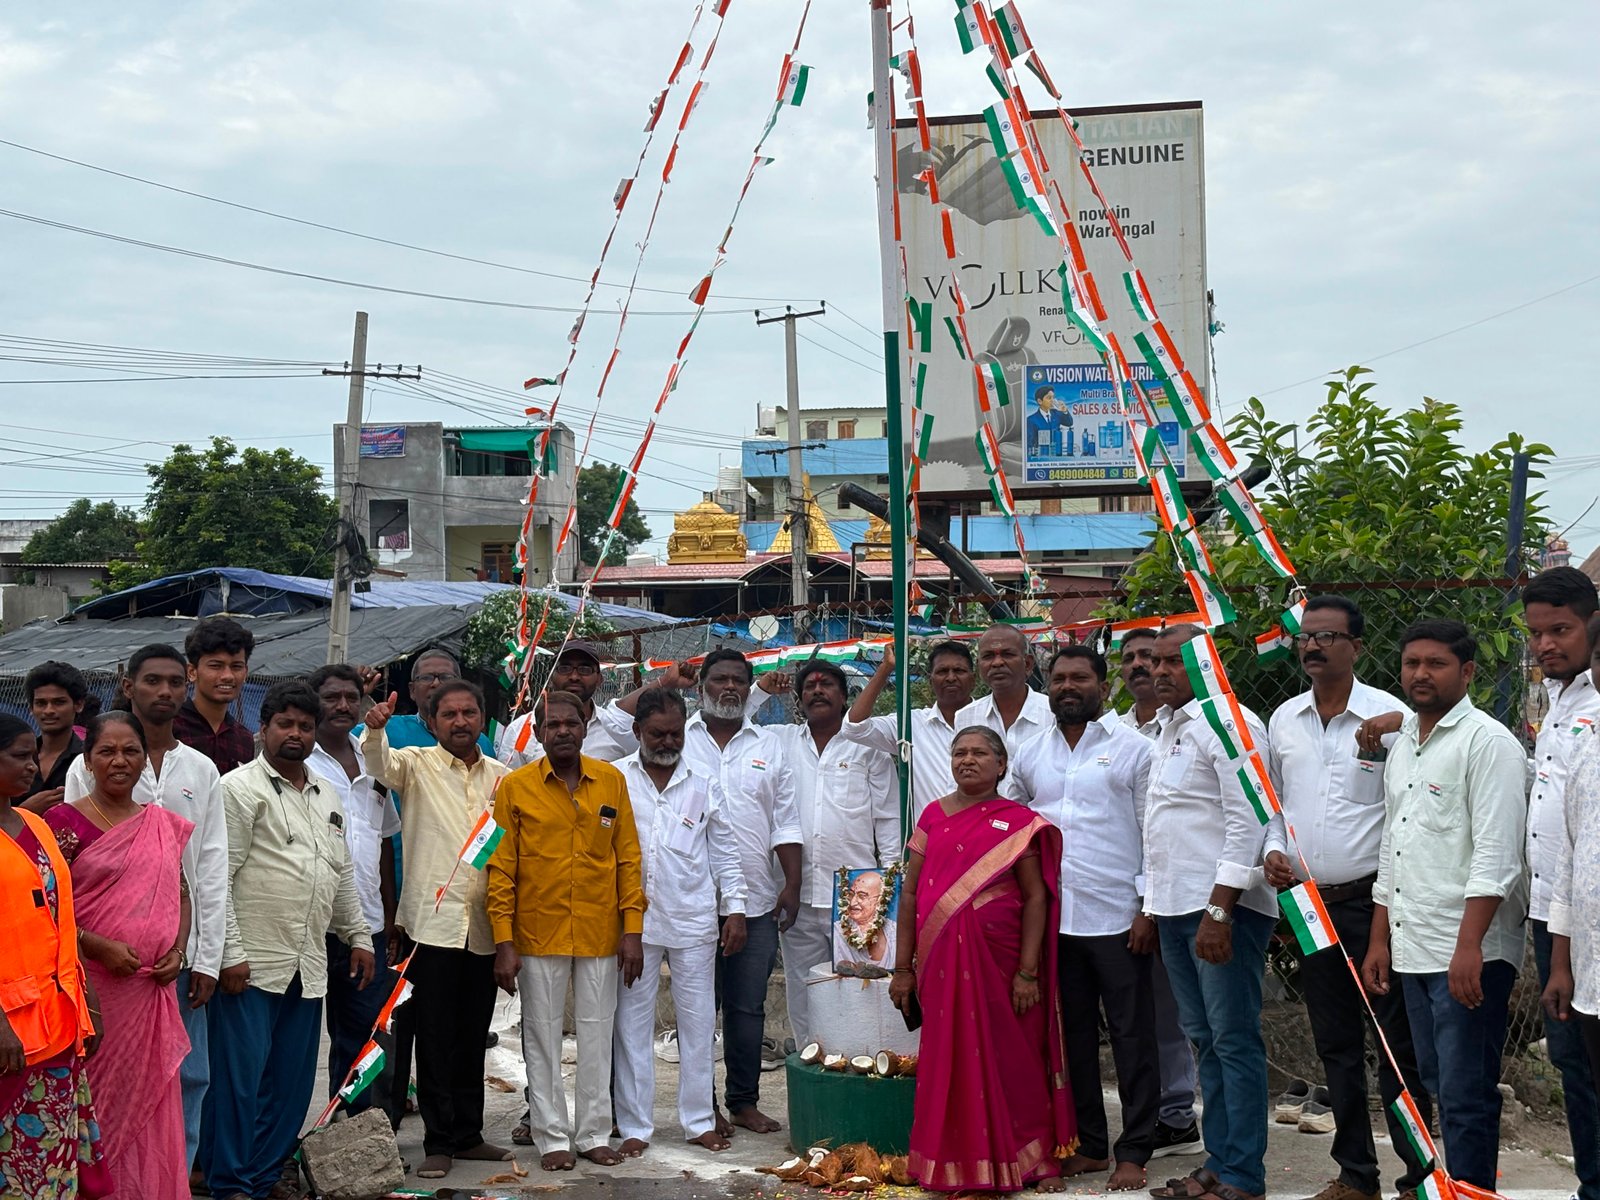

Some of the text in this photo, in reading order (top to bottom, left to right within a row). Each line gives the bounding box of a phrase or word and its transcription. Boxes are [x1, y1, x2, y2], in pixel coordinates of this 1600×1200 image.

[1080, 116, 1184, 140] ITALIAN
[1080, 143, 1185, 167] GENUINE
[1079, 205, 1130, 221] now in
[1079, 220, 1155, 239] Warngal
[922, 263, 1061, 310] VOLLK
[1039, 306, 1066, 316] Rena
[1046, 367, 1083, 383] VISION
[1085, 365, 1113, 381] WATE
[1081, 389, 1100, 399] Multi
[1103, 388, 1116, 398] Bra
[1072, 401, 1142, 415] SALES & SEVIC
[1049, 468, 1105, 480] 8499004848
